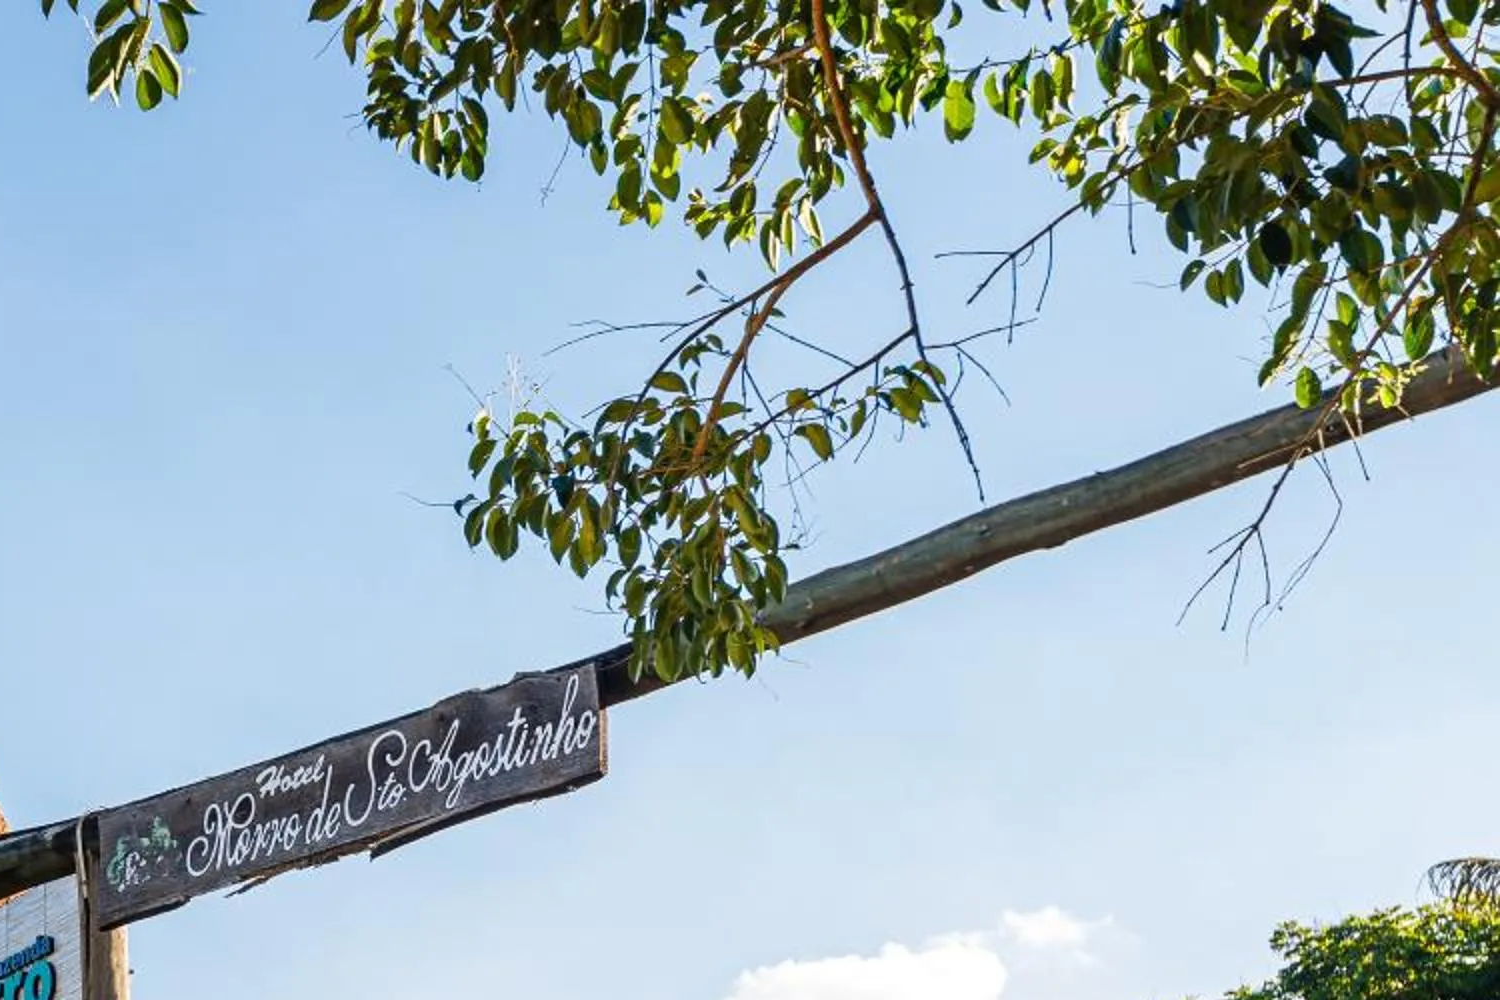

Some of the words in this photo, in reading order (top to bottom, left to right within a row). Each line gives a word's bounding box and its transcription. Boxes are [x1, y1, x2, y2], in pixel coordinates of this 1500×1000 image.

[186, 793, 303, 877] Morro
[305, 764, 342, 845] de
[407, 674, 597, 809] Agostinho
[256, 754, 325, 798] Hotel
